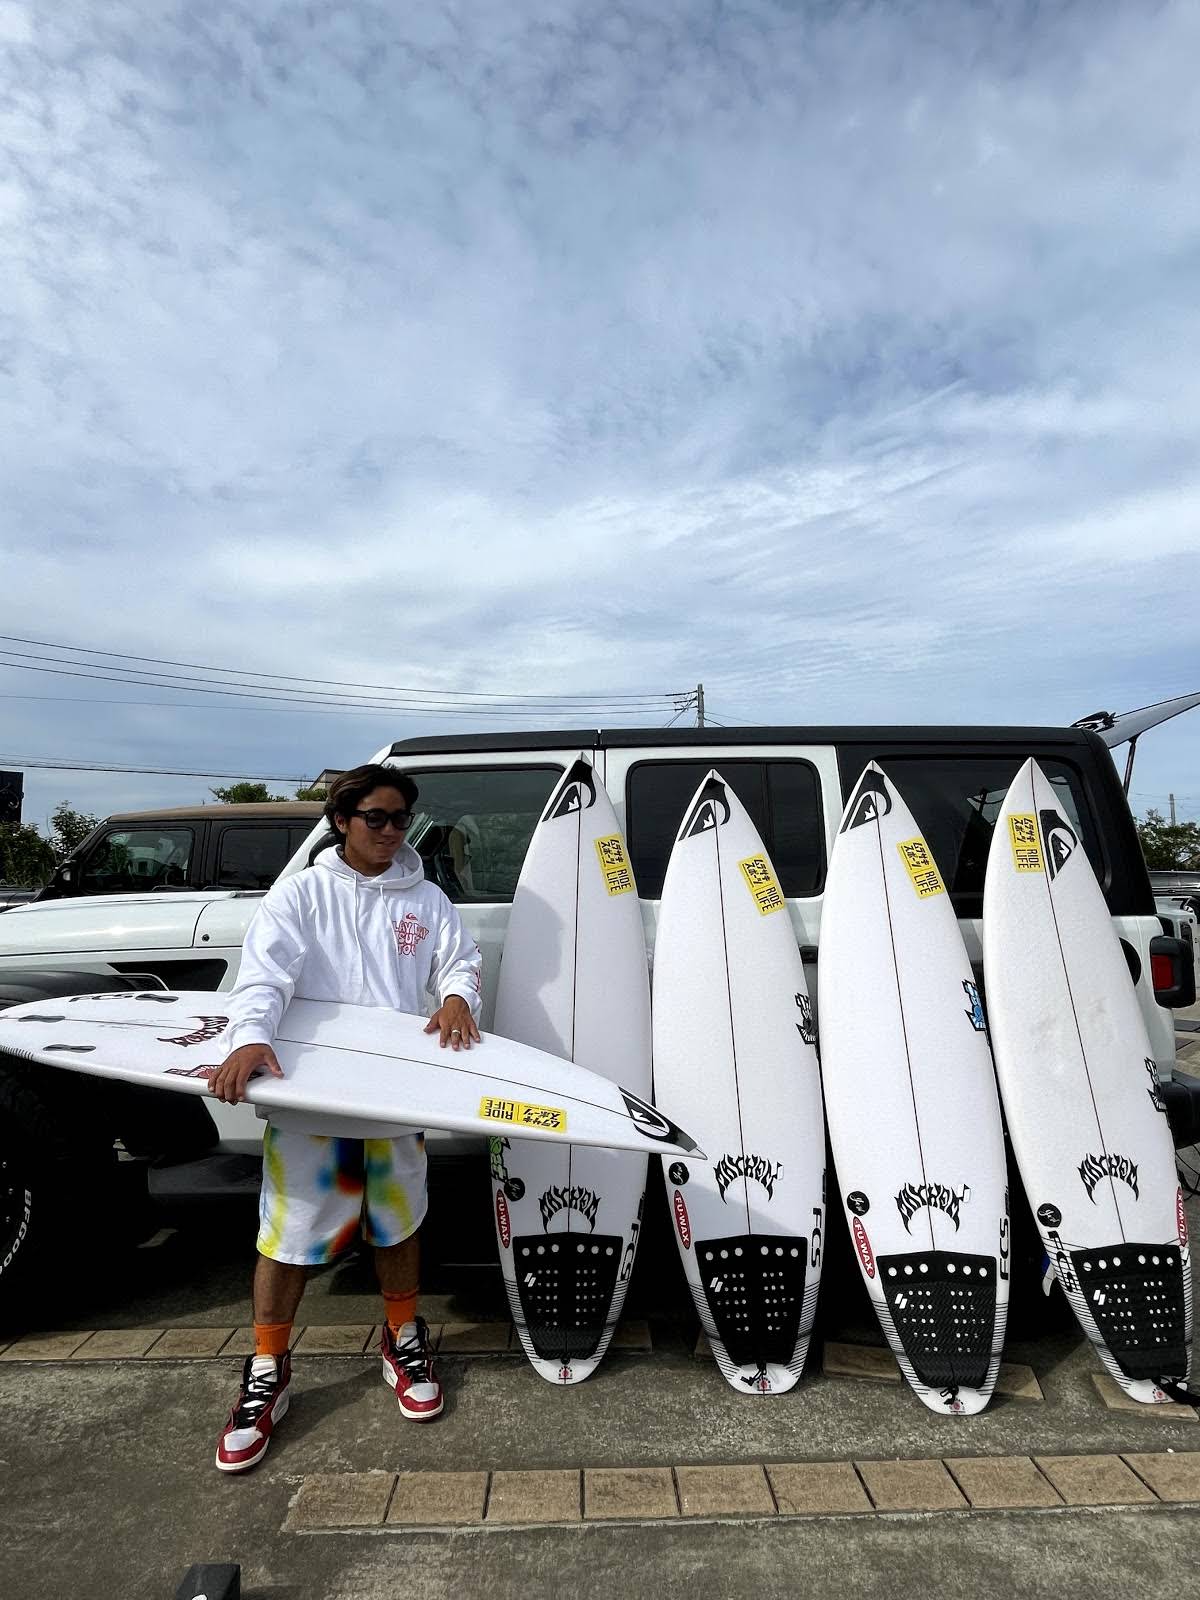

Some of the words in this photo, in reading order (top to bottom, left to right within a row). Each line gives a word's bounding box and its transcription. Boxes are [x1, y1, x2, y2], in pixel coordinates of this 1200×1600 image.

[1016, 849, 1029, 869] LIFE
[1027, 848, 1040, 868] RIDE
[606, 871, 621, 892] LIFE
[617, 868, 632, 890] RIDE
[914, 874, 930, 895] LIFE
[924, 870, 941, 892] RIDE
[755, 890, 772, 912] LIFE
[766, 886, 783, 908] RIDE
[485, 1099, 514, 1111] LIFE
[485, 1109, 513, 1121] RIDE
